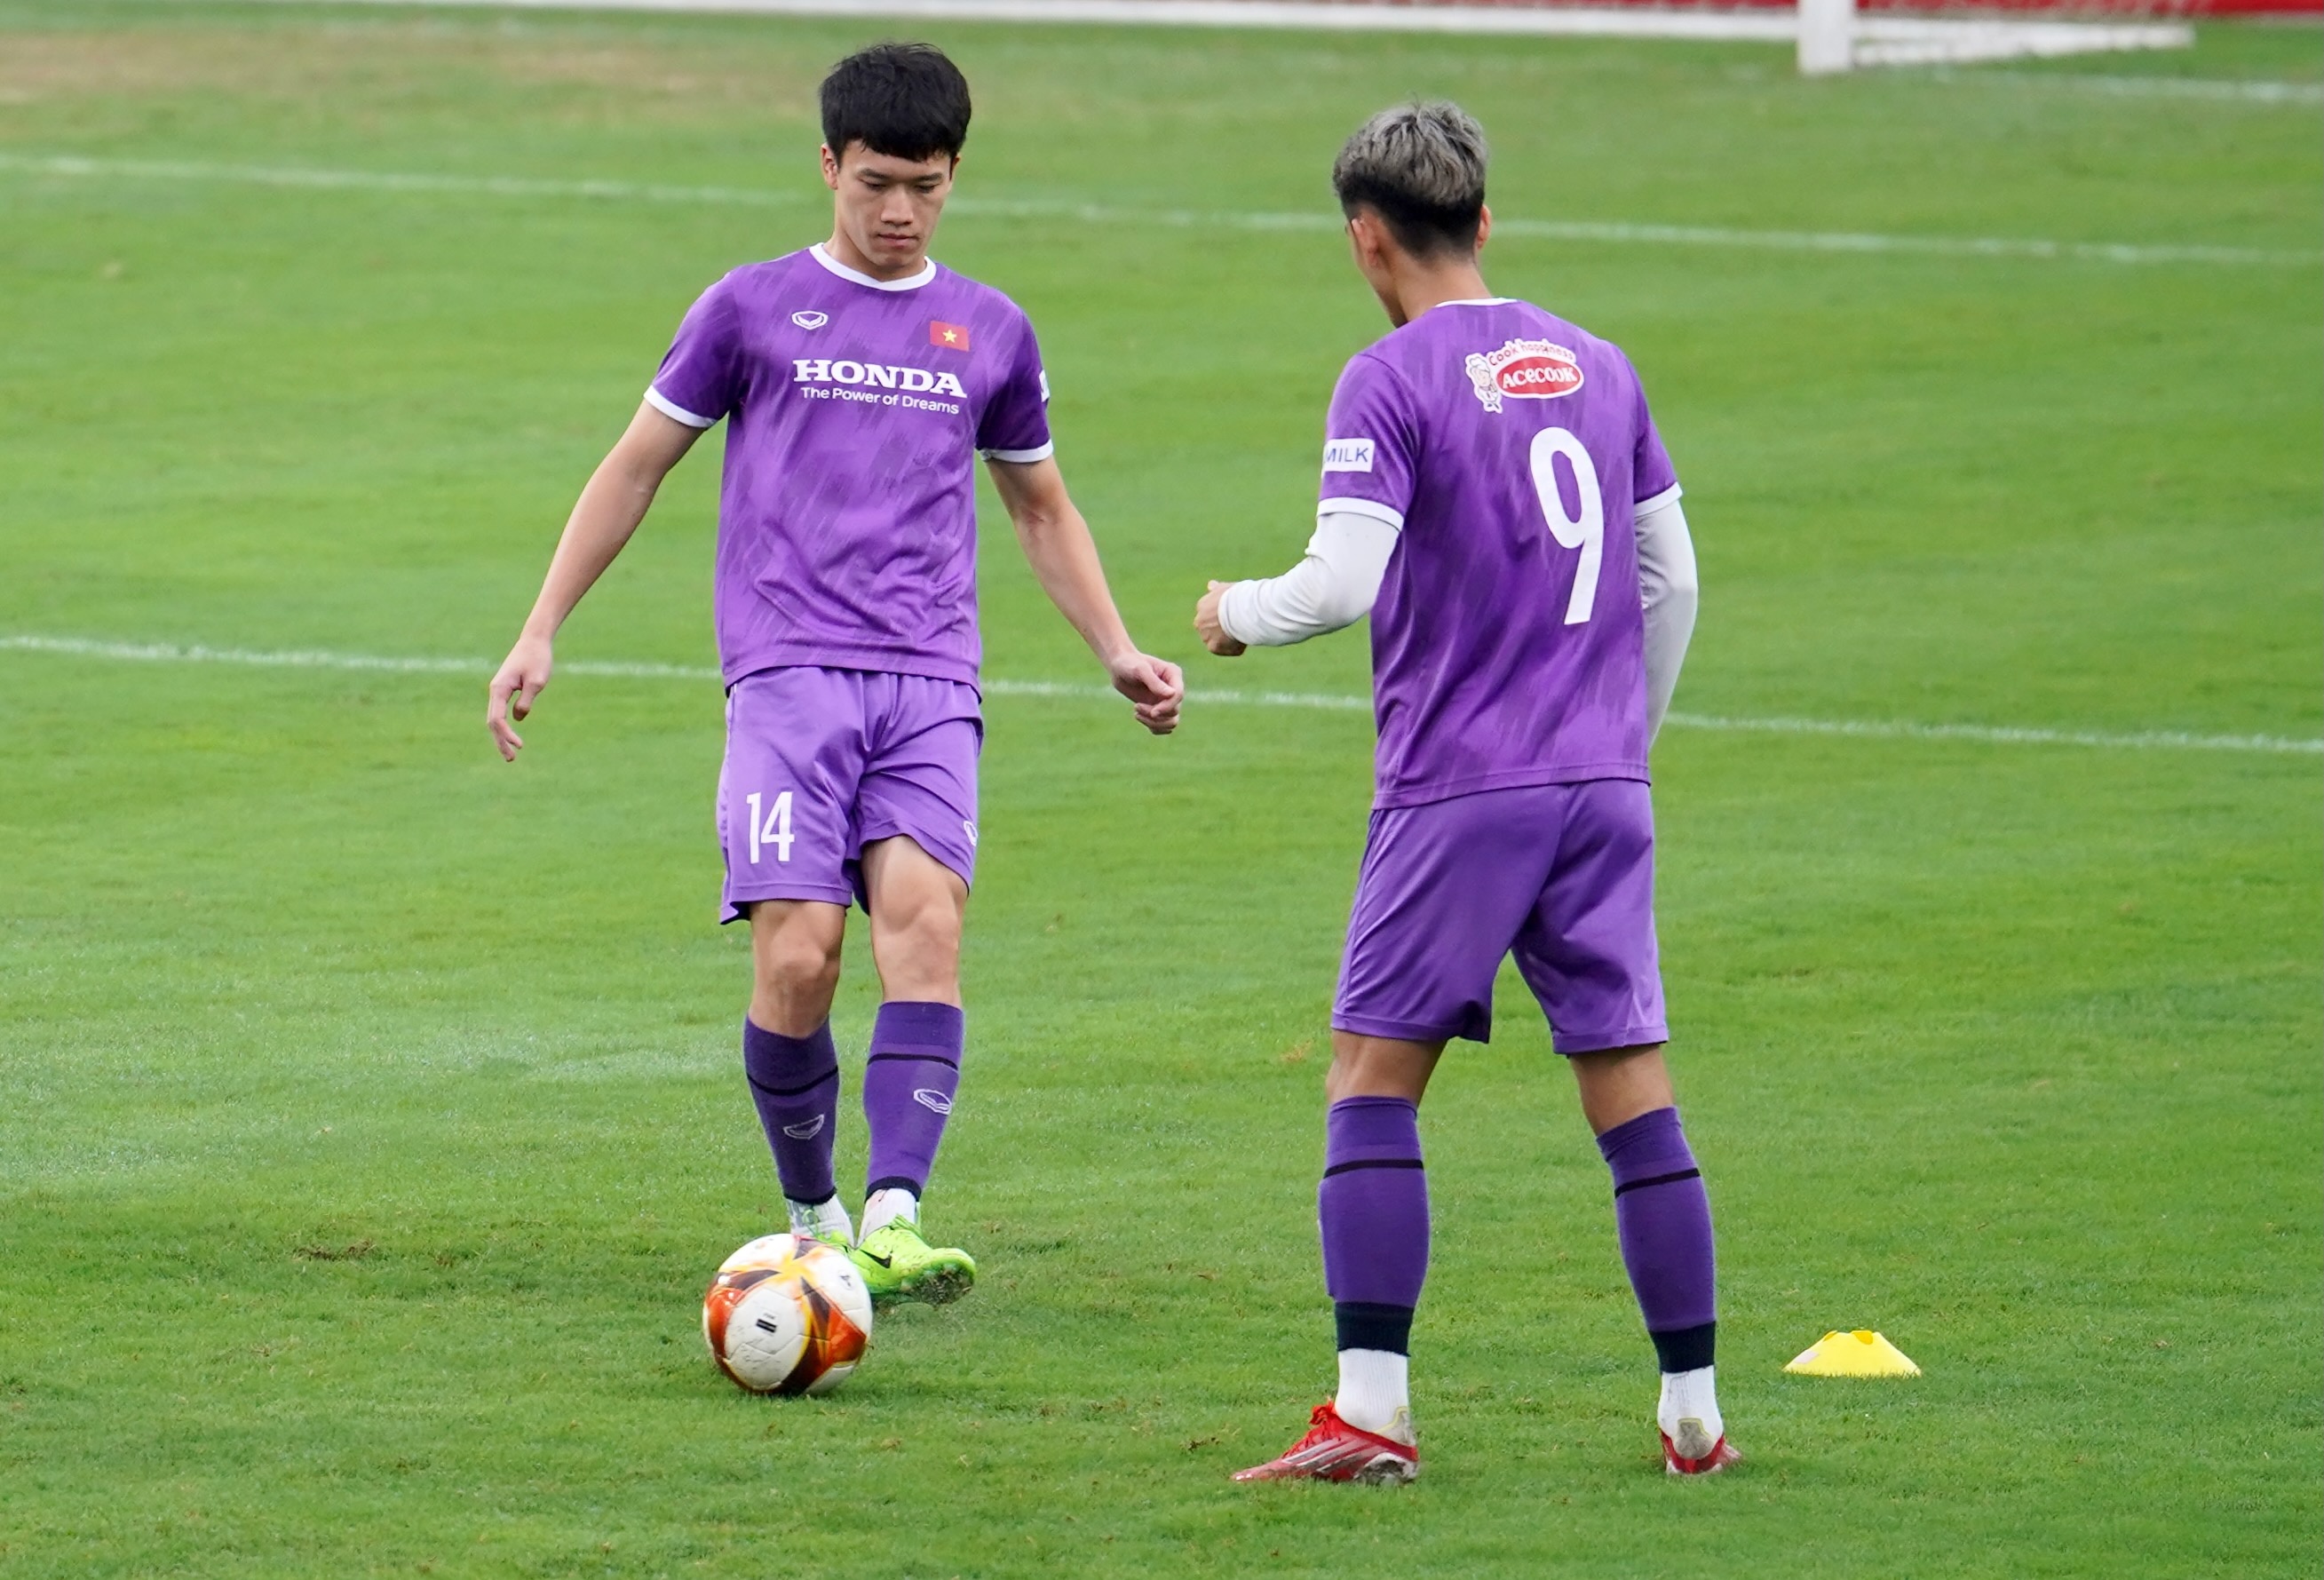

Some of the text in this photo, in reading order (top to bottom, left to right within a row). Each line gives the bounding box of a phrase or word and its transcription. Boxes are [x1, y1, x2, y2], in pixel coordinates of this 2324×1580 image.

[1488, 342, 1574, 366] Cook happiness
[792, 359, 967, 399] HONDA
[800, 387, 959, 415] The Power of Dreams
[1327, 448, 1368, 462] MILK
[1530, 426, 1604, 625] 9
[746, 791, 795, 864] 14
